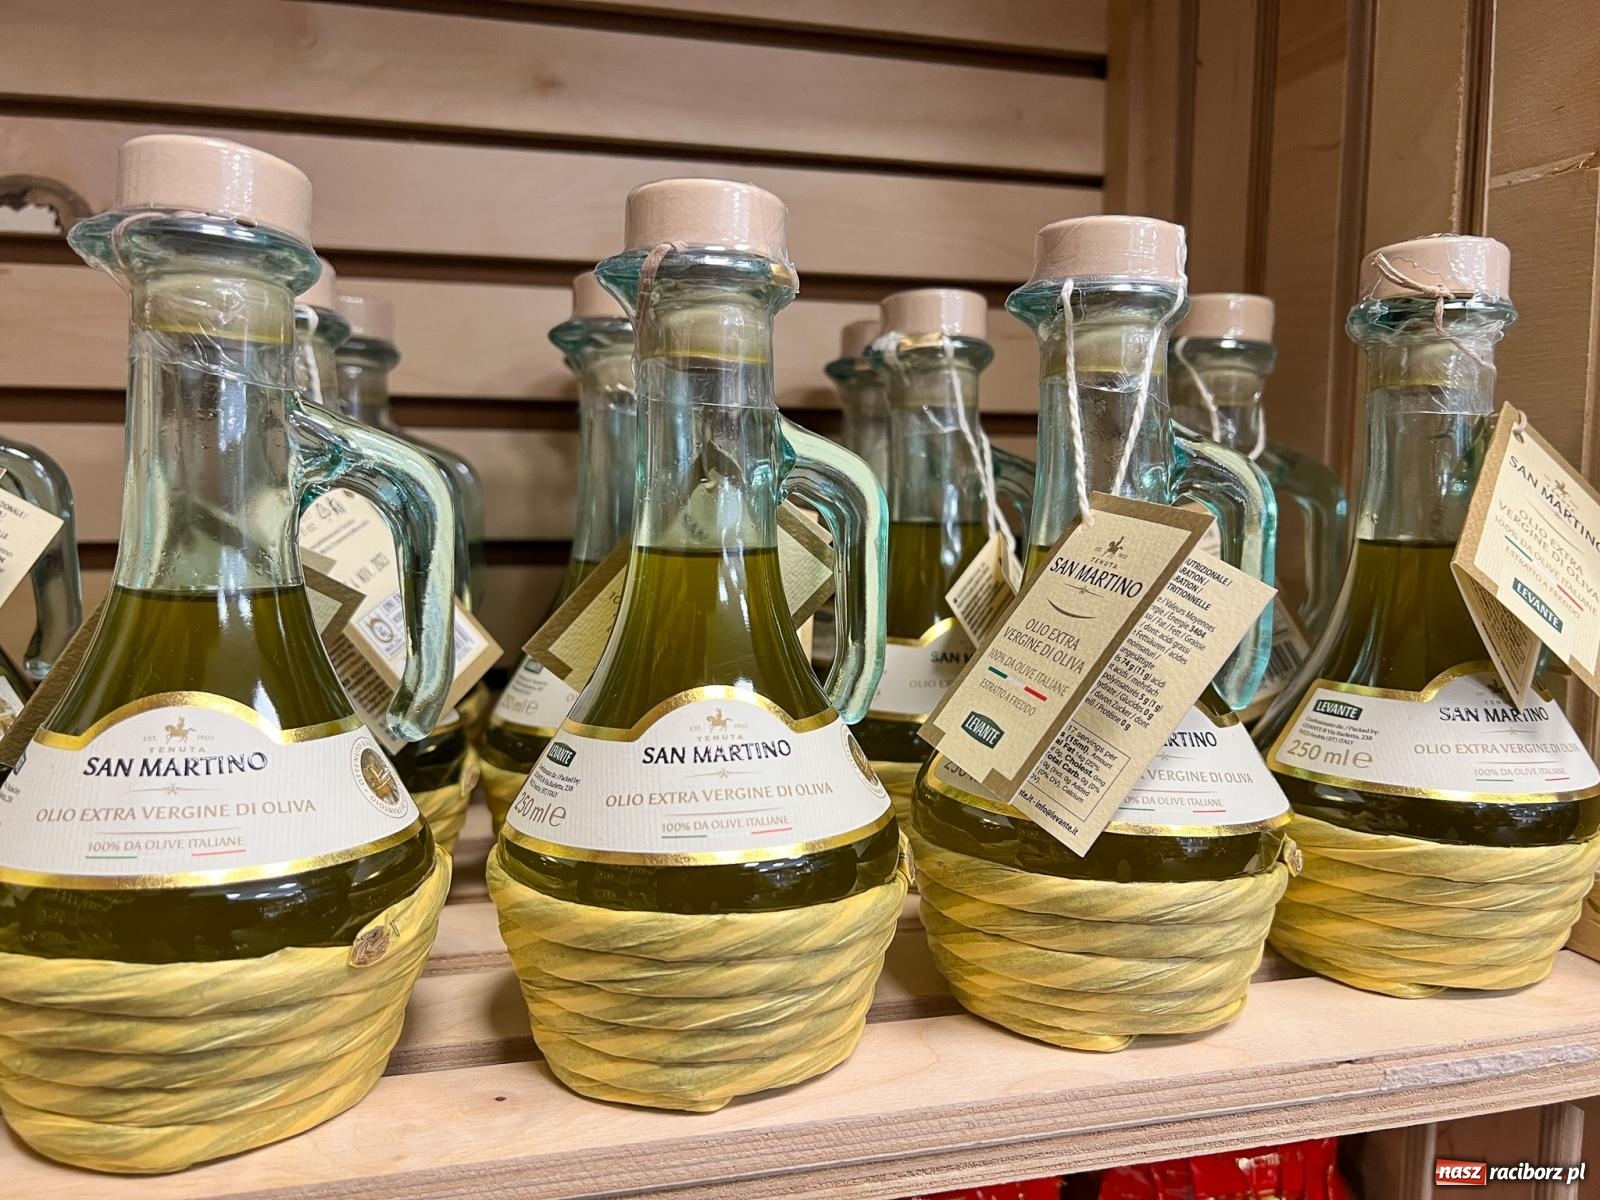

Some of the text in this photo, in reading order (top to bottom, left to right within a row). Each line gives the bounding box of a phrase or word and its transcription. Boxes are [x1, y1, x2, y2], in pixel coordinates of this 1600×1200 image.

[1509, 455, 1538, 488] SAN
[1499, 500, 1599, 602] VERGINE DI OLIVA
[1519, 509, 1584, 576] OLIO EXTRA
[1090, 556, 1118, 570] TENUTA
[1179, 566, 1206, 585] RATION
[1495, 515, 1518, 540] 100%
[1534, 552, 1560, 580] OLIVE
[1561, 577, 1598, 616] ITALIANE
[1050, 557, 1143, 598] SAN MARTINO
[1173, 575, 1198, 592] RATION
[1505, 545, 1581, 619] ESTRATTO FREDDO
[1165, 599, 1217, 633] Valeurs Moyennes
[1517, 582, 1559, 629] LEVANTE
[1026, 618, 1081, 651] OLIO EXTRA
[1156, 618, 1166, 629] Fat
[1168, 625, 1181, 637] Fett
[1184, 634, 1206, 651] Graisse
[1159, 633, 1191, 654] acidi grassi
[1189, 625, 1207, 639] 3404
[931, 651, 956, 663] SAN
[1003, 626, 1085, 674] VERGINE DI OLIVA
[1168, 649, 1188, 665] acides
[909, 679, 936, 688] OLIO
[988, 648, 1071, 697] 100% DA OLIVE ITALIANE
[1113, 665, 1160, 697] acids mehrfach
[1121, 658, 1130, 667] 74
[1151, 677, 1167, 688] acidi
[979, 678, 1006, 699] ESTRATTO
[1009, 695, 1037, 716] FREDDO
[1094, 689, 1150, 729] davon Zucker dont
[1120, 693, 1144, 713] Glucides
[1143, 708, 1149, 716] 0
[1316, 701, 1358, 719] LEVANTE
[1097, 703, 1122, 724] Protéine
[1120, 719, 1127, 727] 0
[1439, 706, 1480, 722] SAN
[964, 714, 1001, 745] LEVANTE
[1338, 737, 1355, 745] ITALY
[1348, 725, 1370, 734] Packed
[149, 746, 206, 754] TENUTA
[549, 744, 573, 765] LEVANTE
[642, 739, 791, 764] SAN MARTINO
[1068, 725, 1118, 761] 17 servings per
[1287, 739, 1322, 760] 250
[1323, 749, 1350, 766] ml
[1414, 744, 1451, 754] OLIO
[1456, 744, 1500, 754] EXTRA
[1500, 744, 1549, 754] VERGINE
[83, 751, 268, 777] SAN MARTINO
[1063, 743, 1075, 754] Fat
[1075, 751, 1085, 762] 14g
[1085, 758, 1100, 772] (22%
[1065, 754, 1106, 787] Cholest. 0mg
[1090, 752, 1113, 769] Amount
[1042, 760, 1091, 797] 0g 0g Added
[1062, 763, 1080, 780] Carb.
[1080, 777, 1089, 786] 0g
[1088, 782, 1101, 793] (0%
[1147, 769, 1254, 784] VERGINE DI OLIVA
[1475, 767, 1499, 776] 100%
[1500, 768, 1513, 776] DA
[1515, 767, 1537, 776] OLIVE
[605, 782, 833, 807] OLIO EXTRA VERGINE DI OLIVA
[1037, 769, 1049, 779] (0%
[1062, 785, 1084, 804] Calcium
[36, 799, 317, 822] OLIO EXTRA VERGINE DI OLIVA
[515, 792, 535, 817] 250
[529, 803, 552, 824] ml
[1141, 796, 1223, 807] DA OLIVE ITALIANE
[661, 815, 790, 833] 100% DA OLIVE ITALIANE
[1035, 802, 1079, 837] info@levante.it
[88, 836, 246, 853] 100% DA OLIVE ITALIANE
